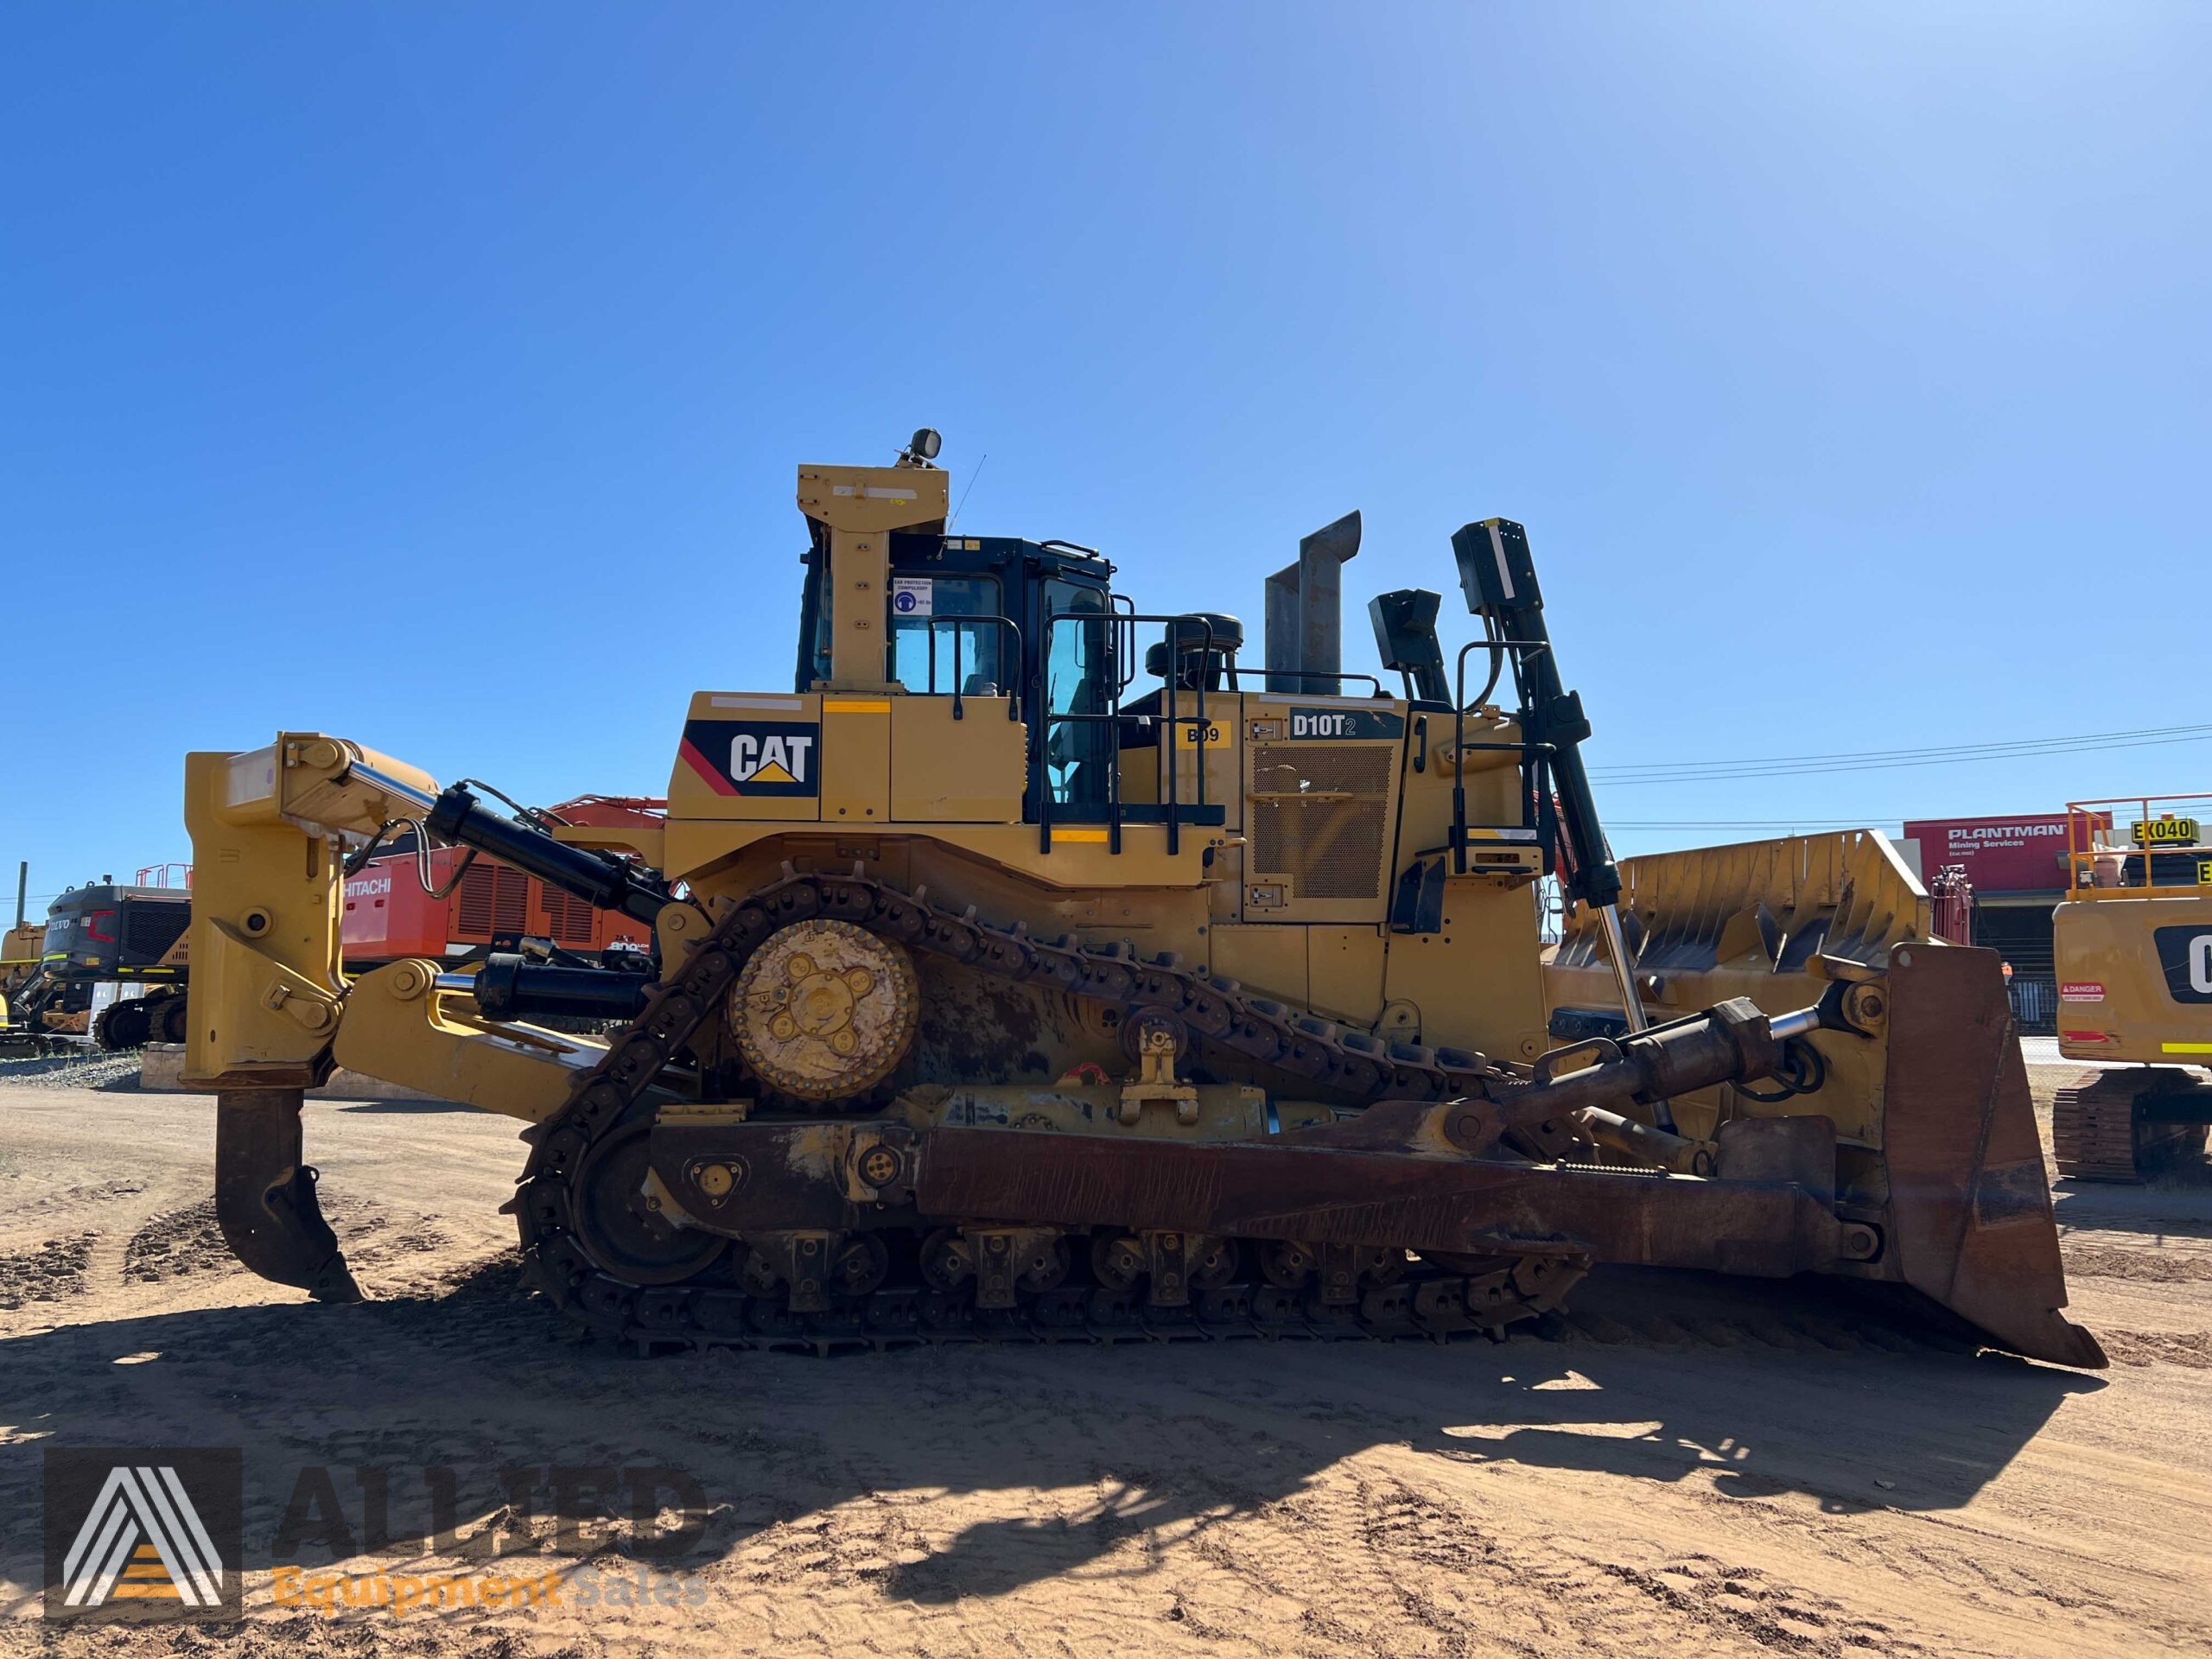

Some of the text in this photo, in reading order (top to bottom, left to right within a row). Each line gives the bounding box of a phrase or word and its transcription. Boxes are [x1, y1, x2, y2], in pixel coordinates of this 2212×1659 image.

[730, 734, 812, 782] CAT
[1948, 824, 2064, 840] PLANTMAN
[1948, 841, 1980, 849] Mining
[343, 878, 391, 897] HITACHI
